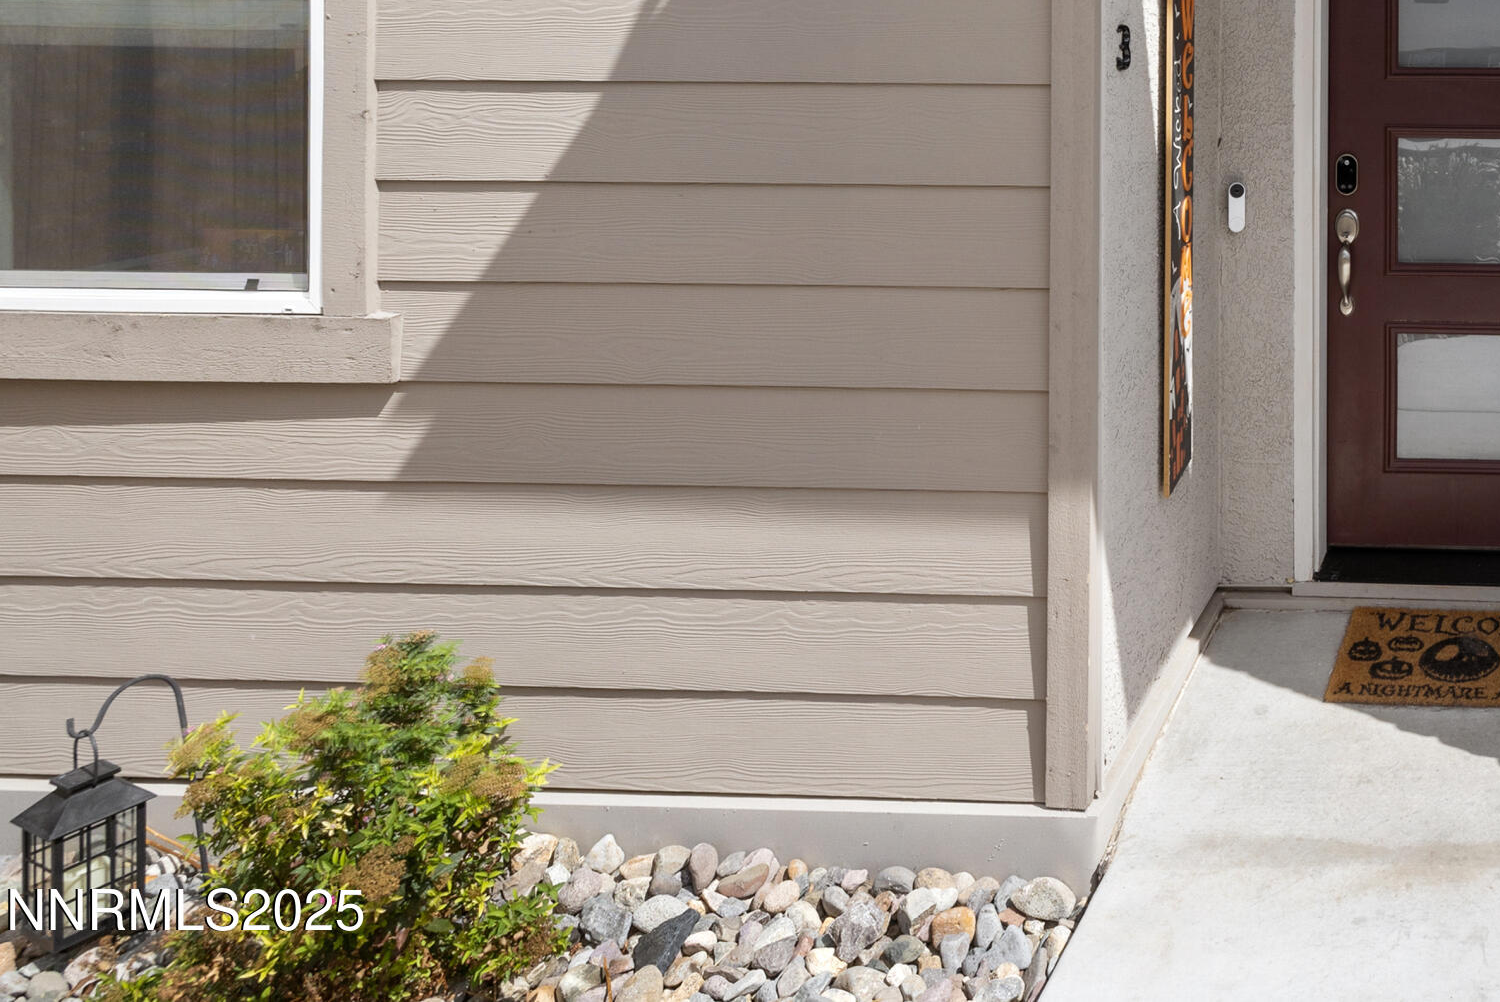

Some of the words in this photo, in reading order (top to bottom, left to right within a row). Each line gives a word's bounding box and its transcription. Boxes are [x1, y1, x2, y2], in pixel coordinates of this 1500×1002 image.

[1116, 24, 1131, 71] 3
[1334, 682, 1354, 695] A
[1360, 683, 1488, 699] NIGHTMARE
